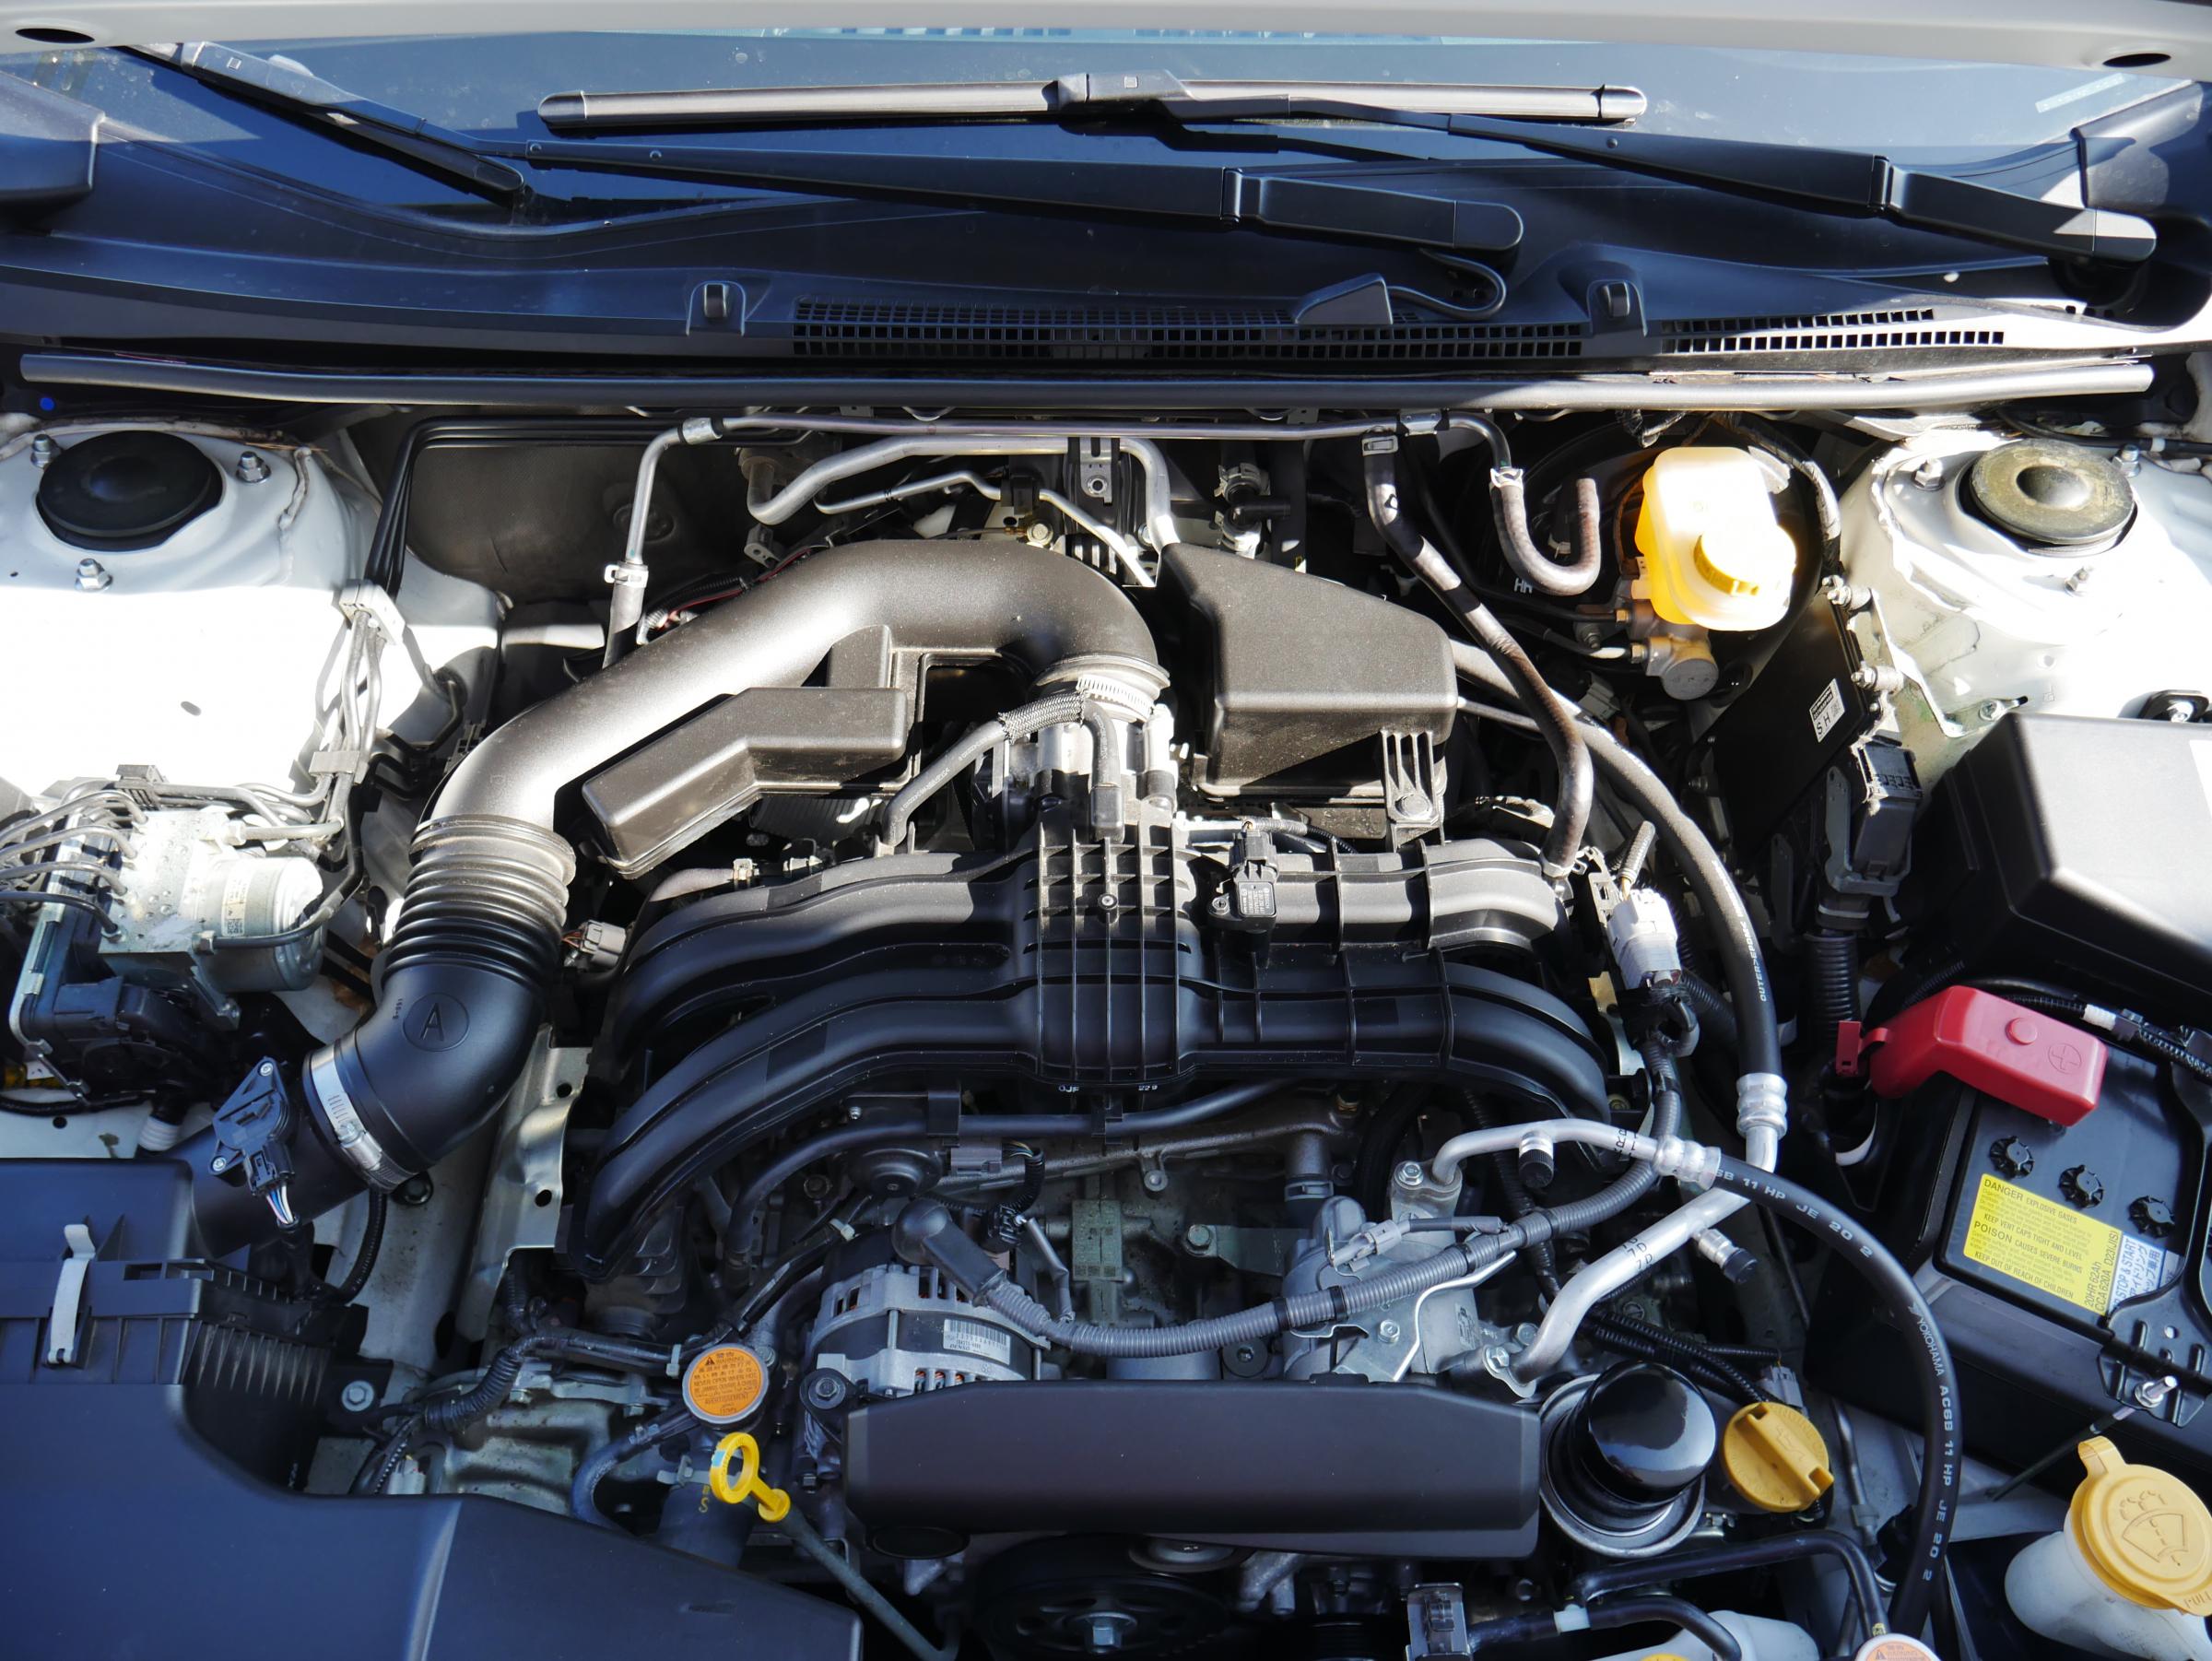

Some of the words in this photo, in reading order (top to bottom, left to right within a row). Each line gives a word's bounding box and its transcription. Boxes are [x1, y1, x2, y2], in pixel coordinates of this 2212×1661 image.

[420, 1002, 444, 1042] A
[1742, 1178, 1759, 1190] 11
[1764, 1185, 1786, 1200] HP
[1795, 1203, 1820, 1219] JE
[1828, 1220, 1853, 1241] 20
[1859, 1245, 1874, 1257] 2
[1983, 1178, 2024, 1201] DANGER
[2026, 1197, 2056, 1215] EXPLOSIVE
[2057, 1210, 2077, 1225] GASES
[1974, 1220, 2013, 1243] POISON
[2015, 1239, 2038, 1255] CAUSES
[2040, 1249, 2060, 1264] SEVERE
[2061, 1258, 2082, 1274] BURNS
[1983, 1212, 1999, 1225] KEEP
[1999, 1219, 2015, 1231] VENT
[2015, 1226, 2031, 1239] CAPS
[2032, 1233, 2050, 1247] TIGHT
[2051, 1241, 2064, 1253] AND
[2065, 1246, 2082, 1260] LEVEL
[1974, 1250, 1990, 1263] KEEP
[1990, 1257, 2004, 1269] OUT
[2004, 1263, 2013, 1273] OF
[2012, 1266, 2033, 1281] REACH
[2033, 1276, 2042, 1286] OF
[2044, 1280, 2074, 1298] CHILDREN
[2099, 1267, 2112, 1291] 620A
[2115, 1273, 2129, 1299] STOP
[2123, 1238, 2136, 1267] START
[2094, 1290, 2107, 1313] CCA
[1917, 1319, 1945, 1376] YOKOHAMA
[1945, 1440, 1954, 1456] 11
[1944, 1464, 1954, 1486] HP
[698, 1497, 709, 1514] S
[1936, 1499, 1947, 1522] JE
[1929, 1532, 1943, 1559] 20
[1923, 1570, 1933, 1581] 2
